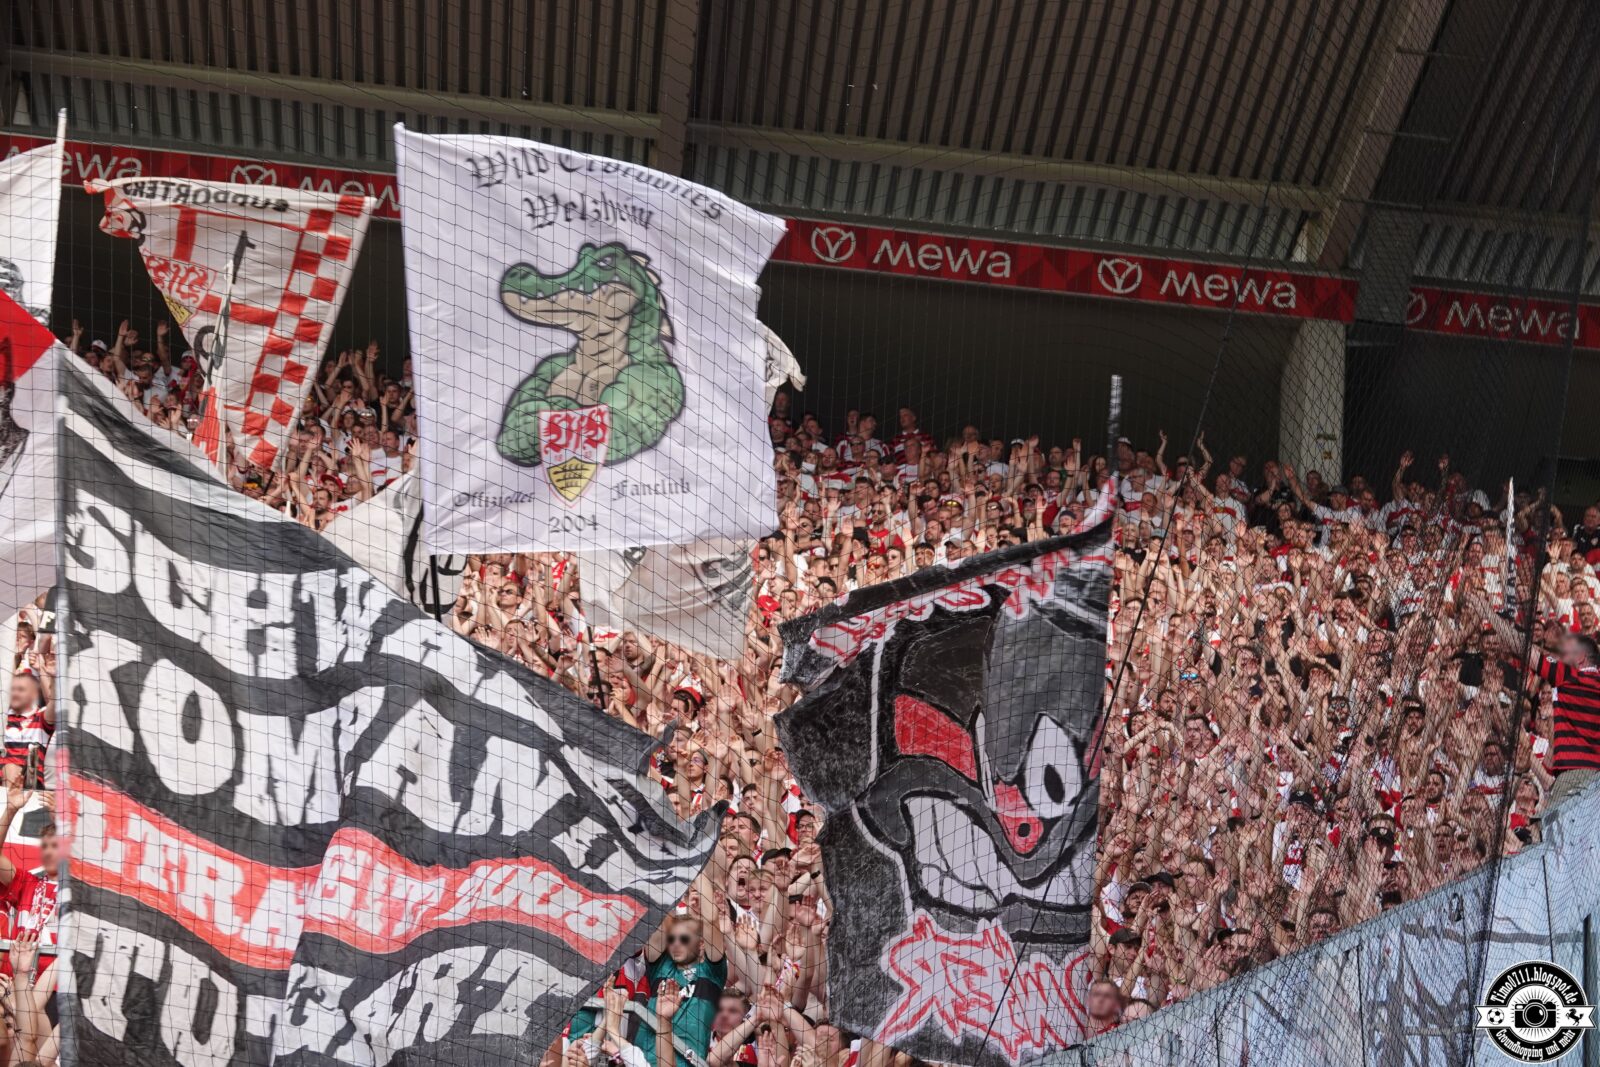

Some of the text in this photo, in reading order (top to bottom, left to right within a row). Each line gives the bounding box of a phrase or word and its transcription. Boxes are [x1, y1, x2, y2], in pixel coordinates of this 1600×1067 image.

[4, 145, 143, 179] ewa
[466, 148, 549, 188] Wild
[299, 176, 401, 212] Mew
[611, 478, 691, 501] Fanclub
[549, 514, 599, 534] 2004
[68, 788, 307, 951] LTRA
